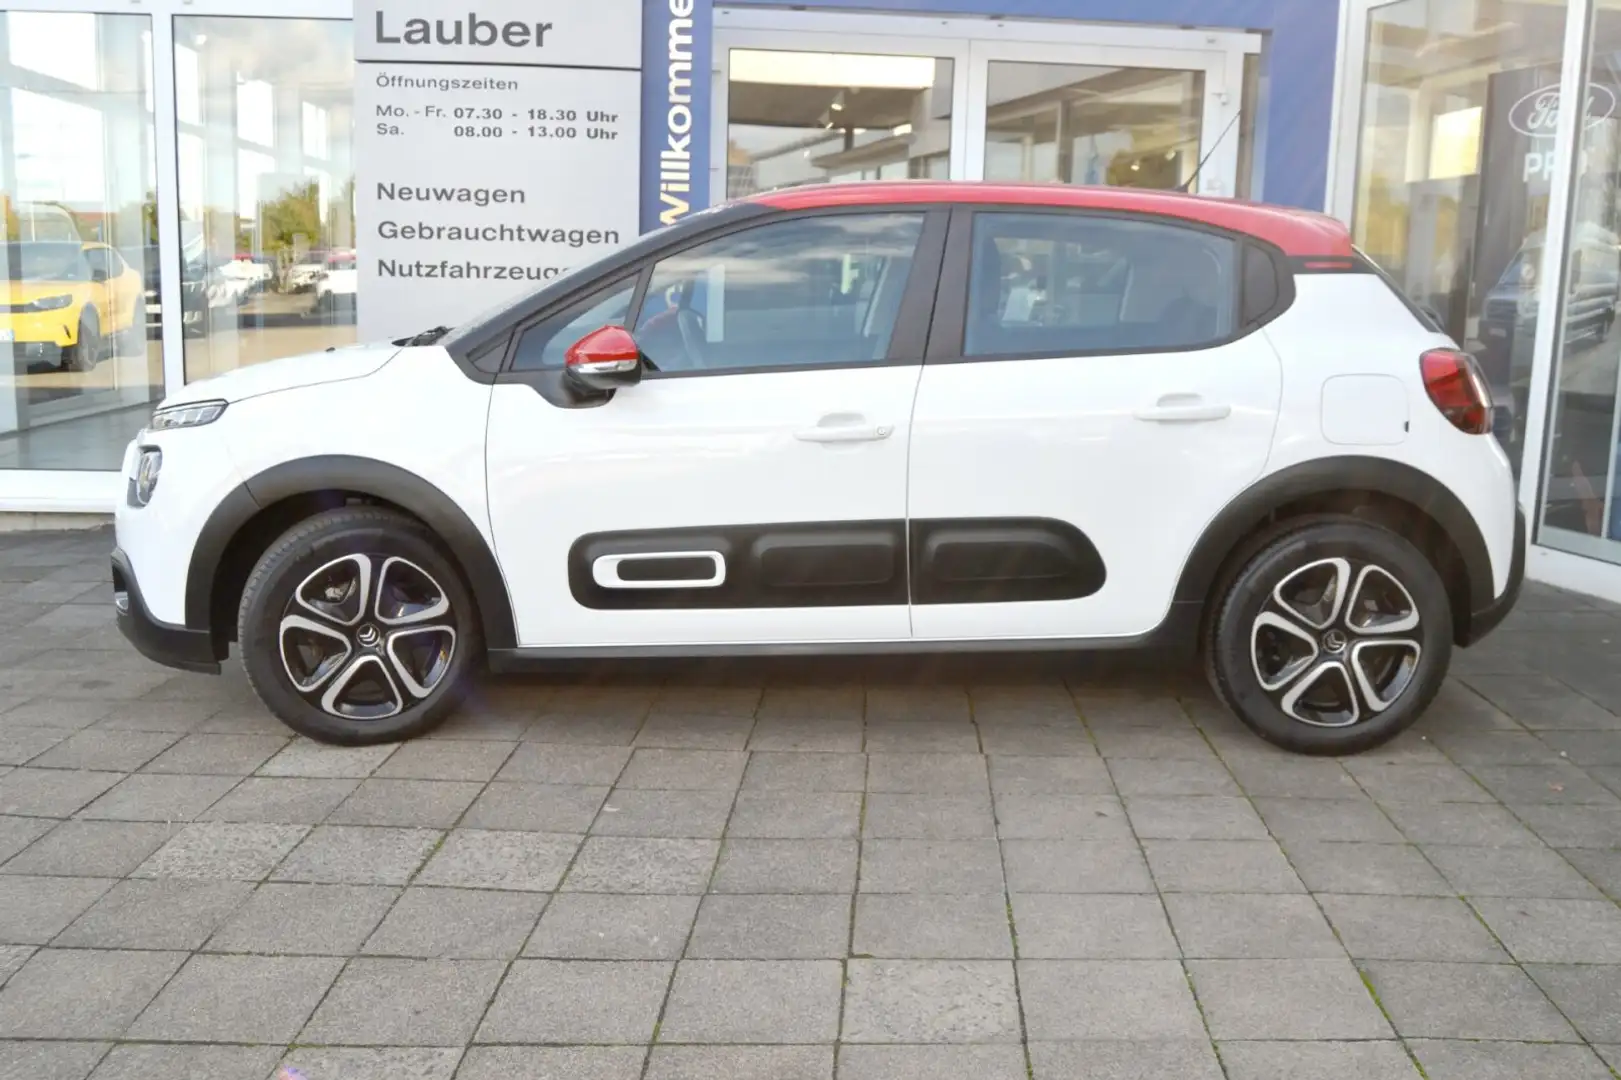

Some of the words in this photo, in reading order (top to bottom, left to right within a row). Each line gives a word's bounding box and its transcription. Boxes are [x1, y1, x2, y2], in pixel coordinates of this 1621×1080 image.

[375, 10, 553, 48] Lauber
[375, 72, 519, 92] Öffnungszeiten
[375, 104, 409, 118] Mo.
[425, 105, 447, 118] Fr.
[453, 107, 503, 121] 07.30
[527, 108, 577, 122] 18.30
[586, 110, 619, 124] Uhr
[376, 122, 405, 136] Sa.
[453, 125, 503, 138] 08.00
[527, 125, 577, 139] 13.00
[586, 127, 619, 140] Uhr
[376, 182, 526, 207] Neuwagen
[377, 220, 621, 248] Gebrauchtwagen
[377, 259, 569, 281] Nutzfahrzeug
